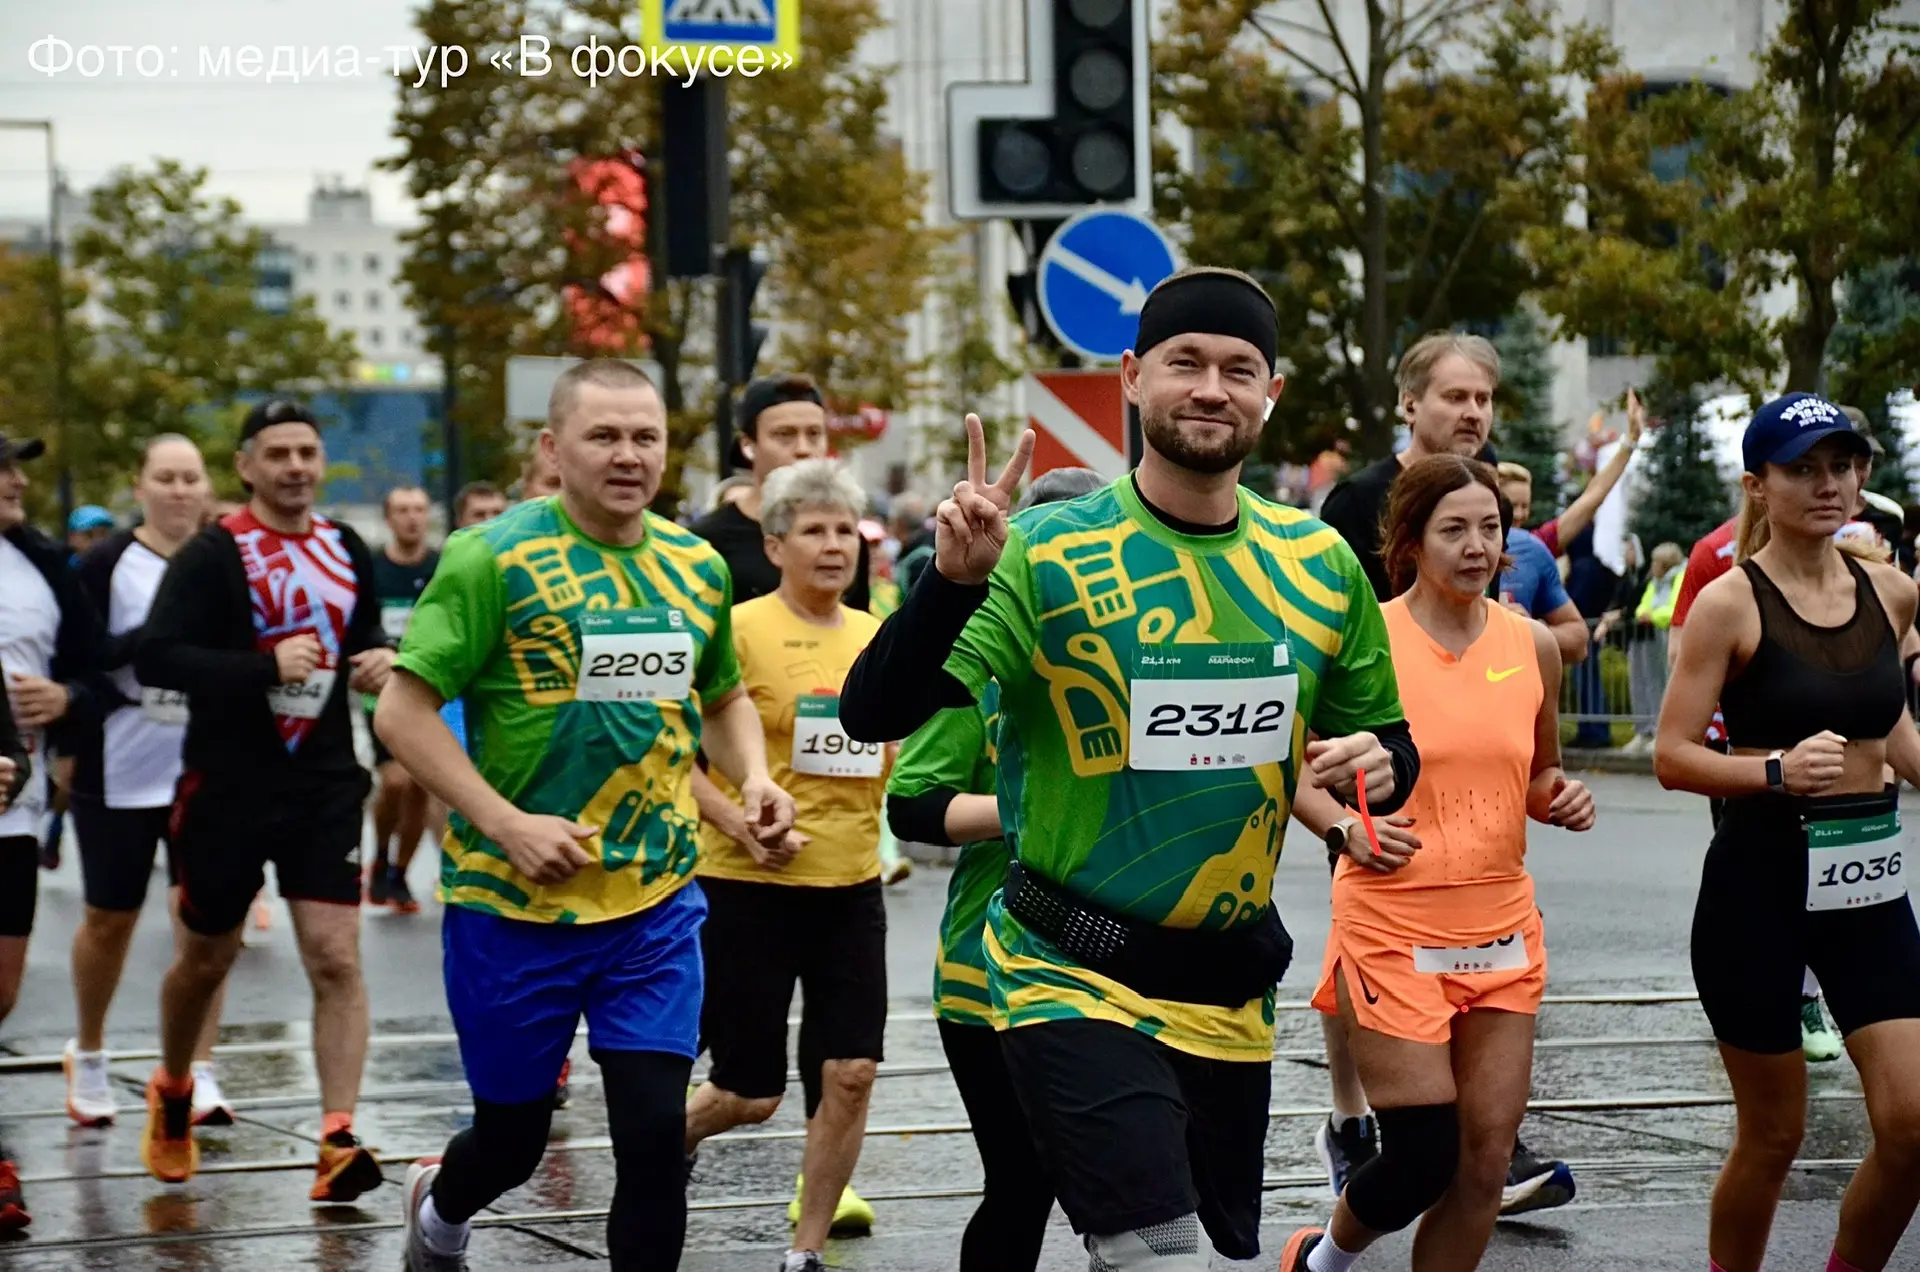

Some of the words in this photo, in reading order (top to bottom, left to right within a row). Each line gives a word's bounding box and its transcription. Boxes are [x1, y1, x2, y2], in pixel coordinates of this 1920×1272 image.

[587, 652, 687, 677] 2203
[1145, 700, 1285, 737] 2312
[1817, 851, 1902, 888] 1036
